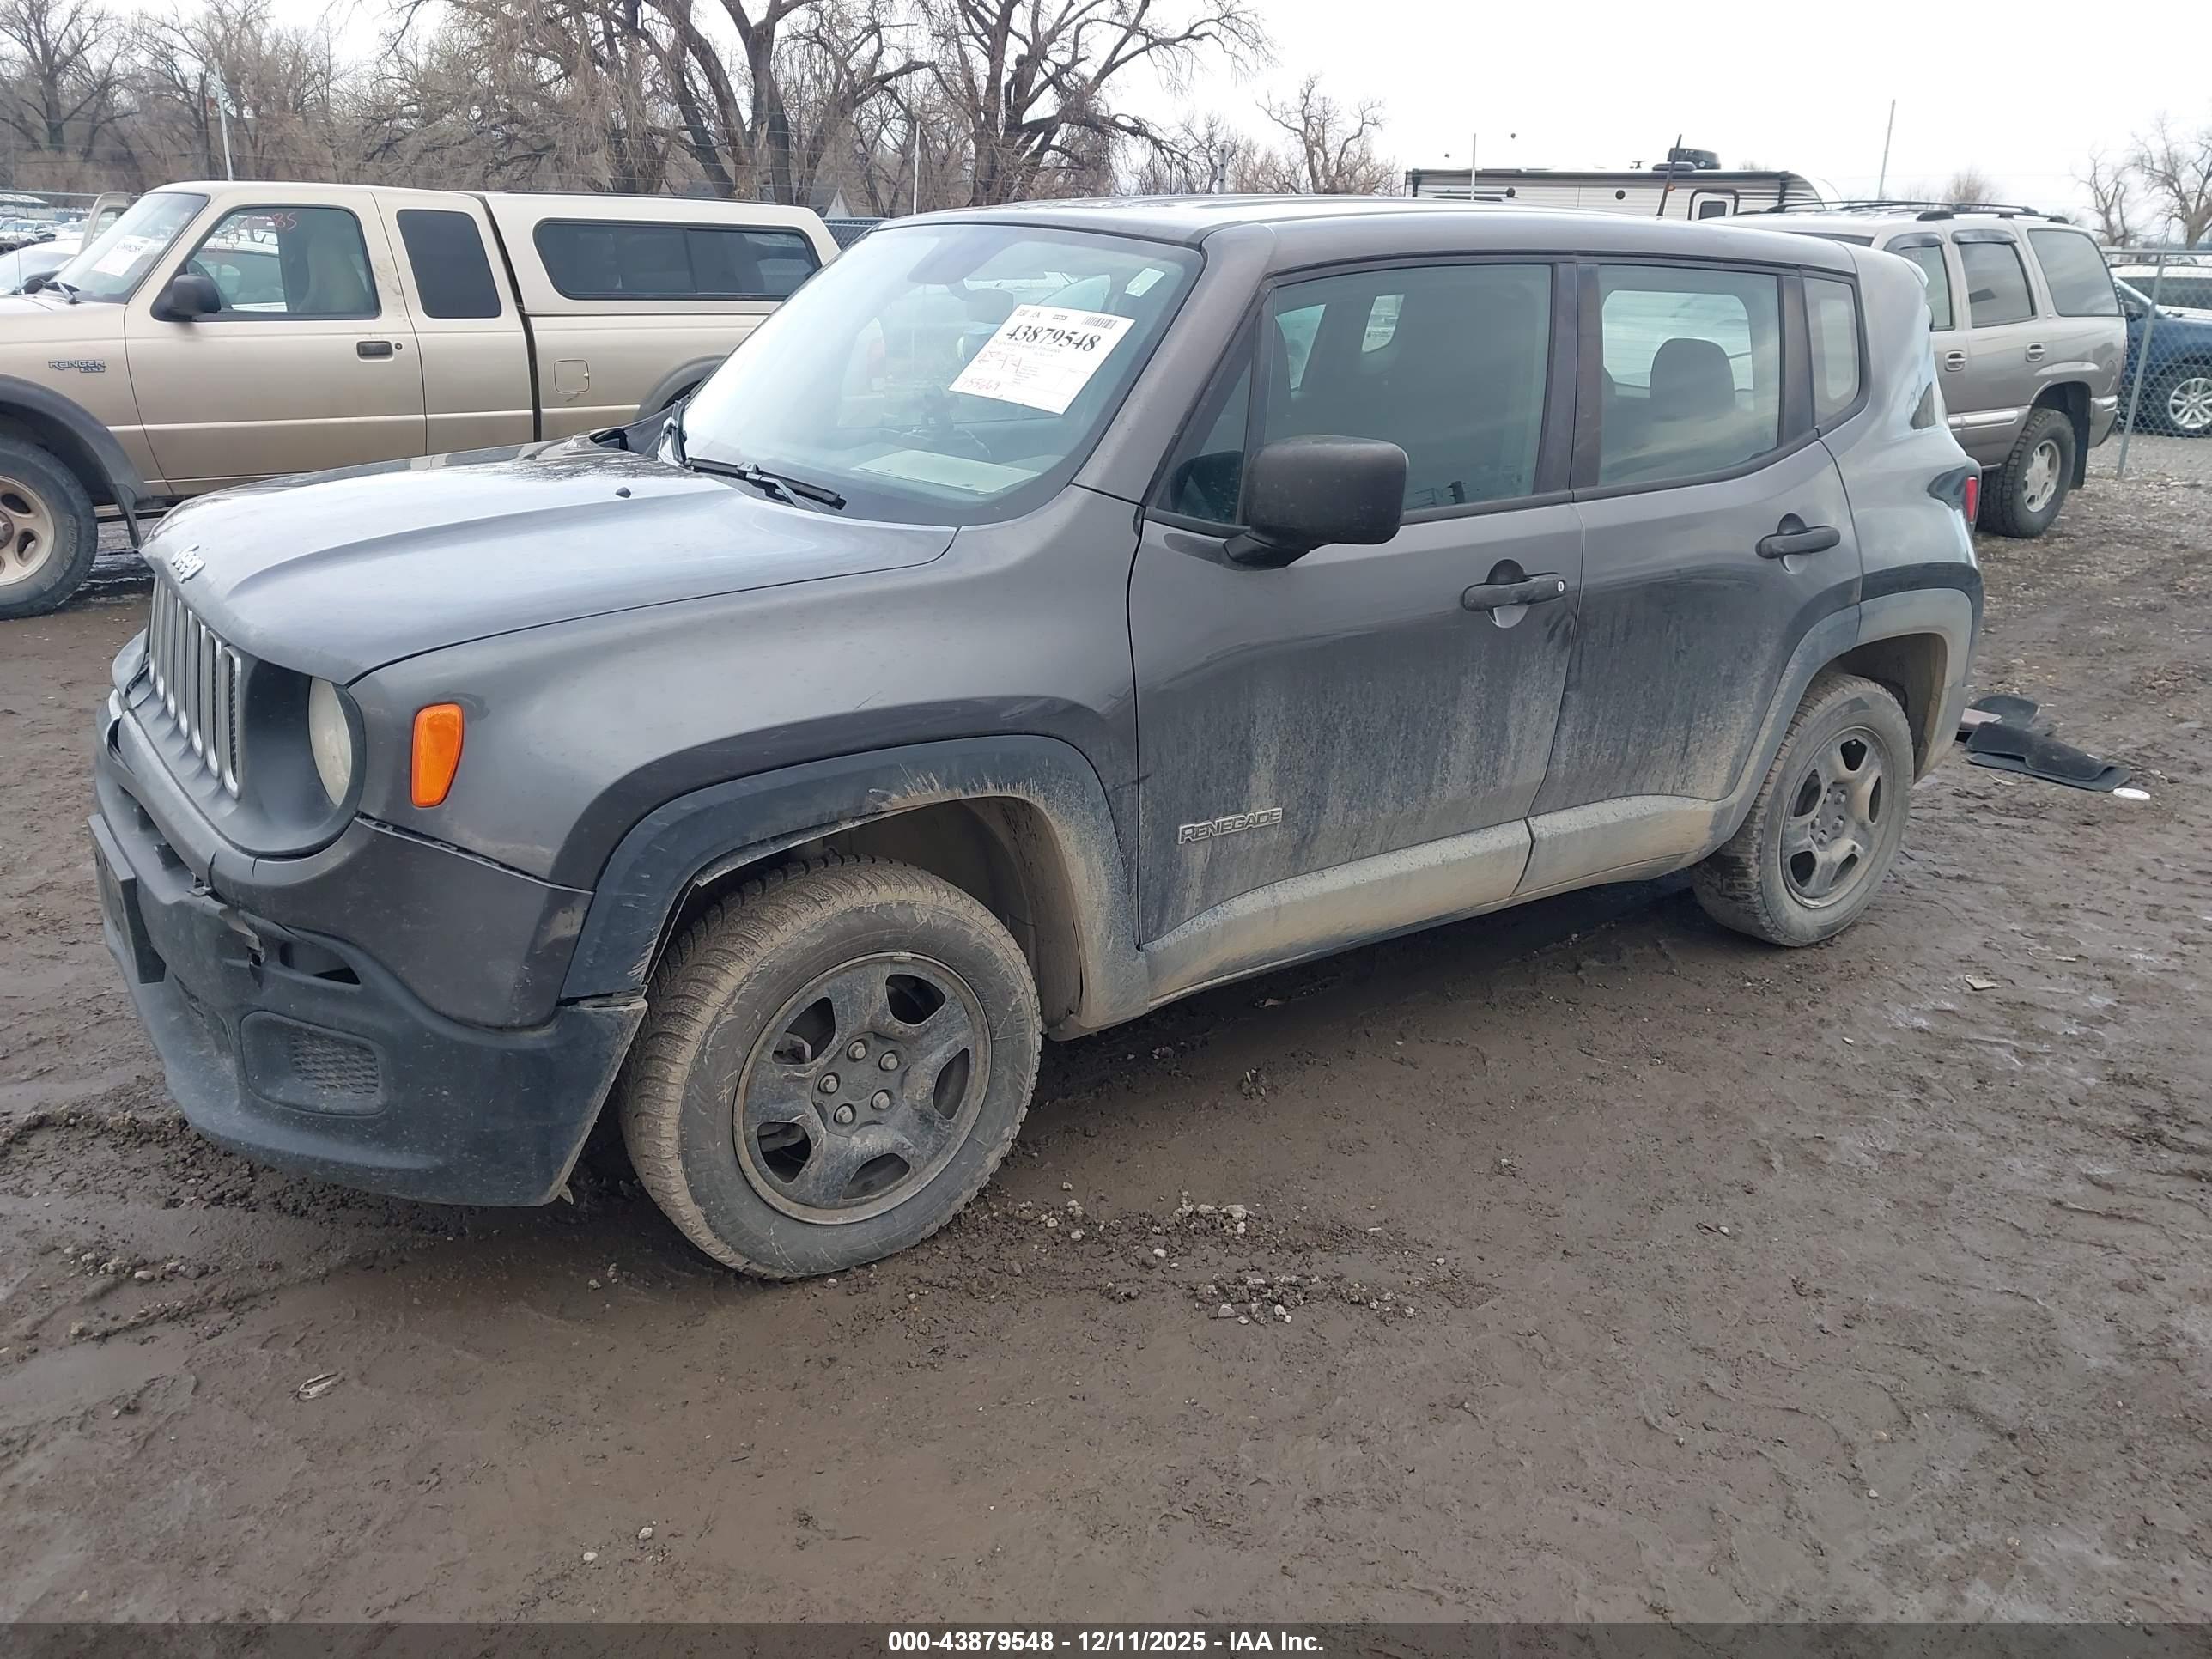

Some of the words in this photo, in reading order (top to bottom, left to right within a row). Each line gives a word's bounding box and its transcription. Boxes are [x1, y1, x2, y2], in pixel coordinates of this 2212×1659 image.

[1006, 324, 1102, 352] 43879548
[171, 544, 206, 585] Jeep
[1178, 807, 1283, 844] RENEGADE
